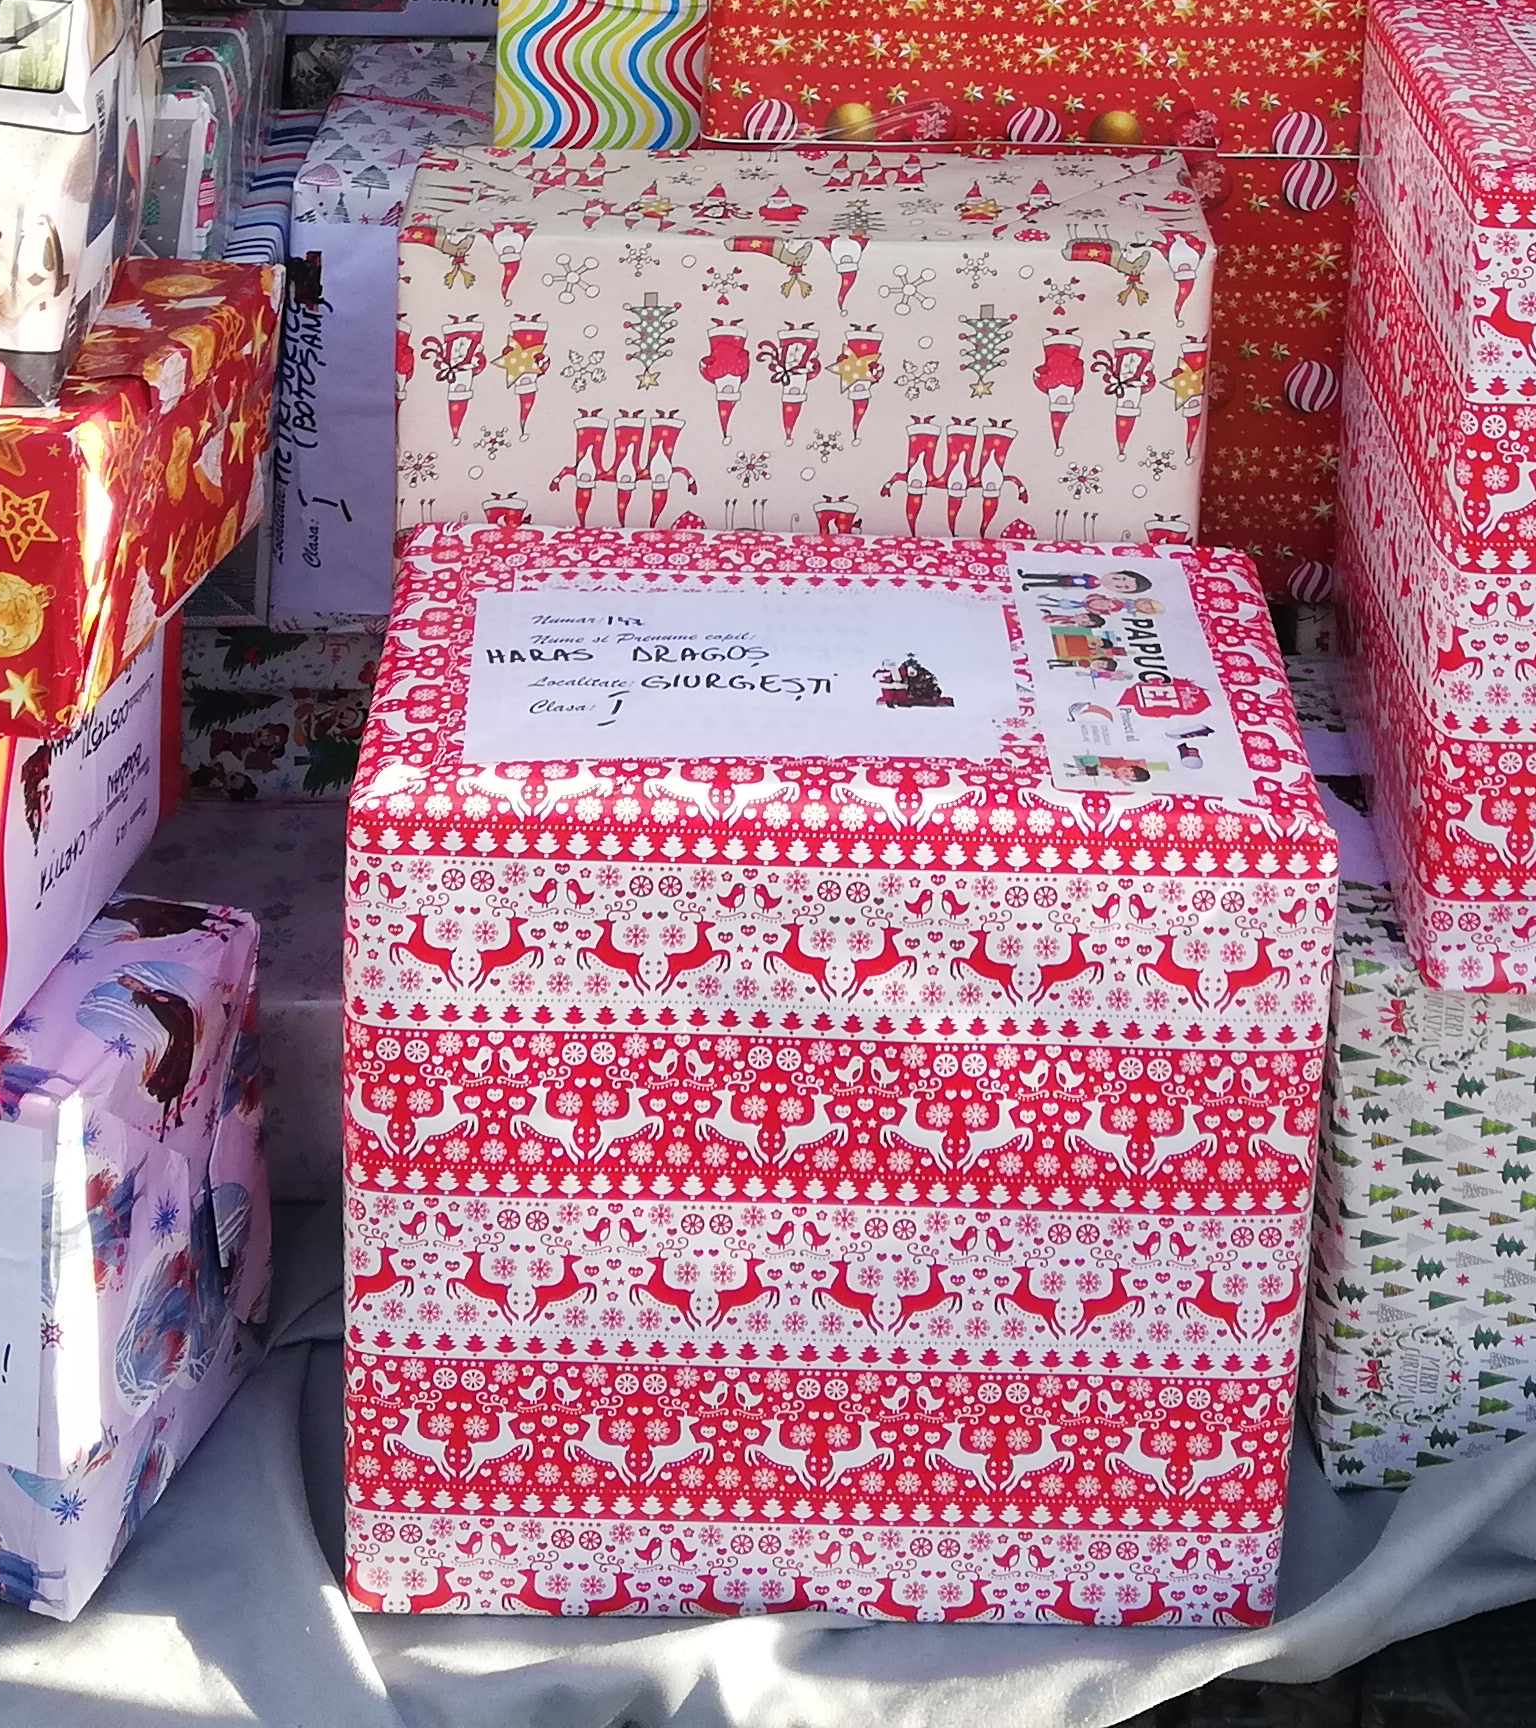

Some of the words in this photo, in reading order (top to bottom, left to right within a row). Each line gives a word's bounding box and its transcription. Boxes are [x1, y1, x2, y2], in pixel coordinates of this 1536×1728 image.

[302, 519, 322, 569] Clasa:
[530, 634, 585, 645] Nume
[616, 632, 699, 645] Prenume
[705, 631, 756, 647] copil:
[485, 645, 595, 665] HARAS
[527, 675, 635, 688] Localitate:
[529, 699, 596, 714] Clasa:
